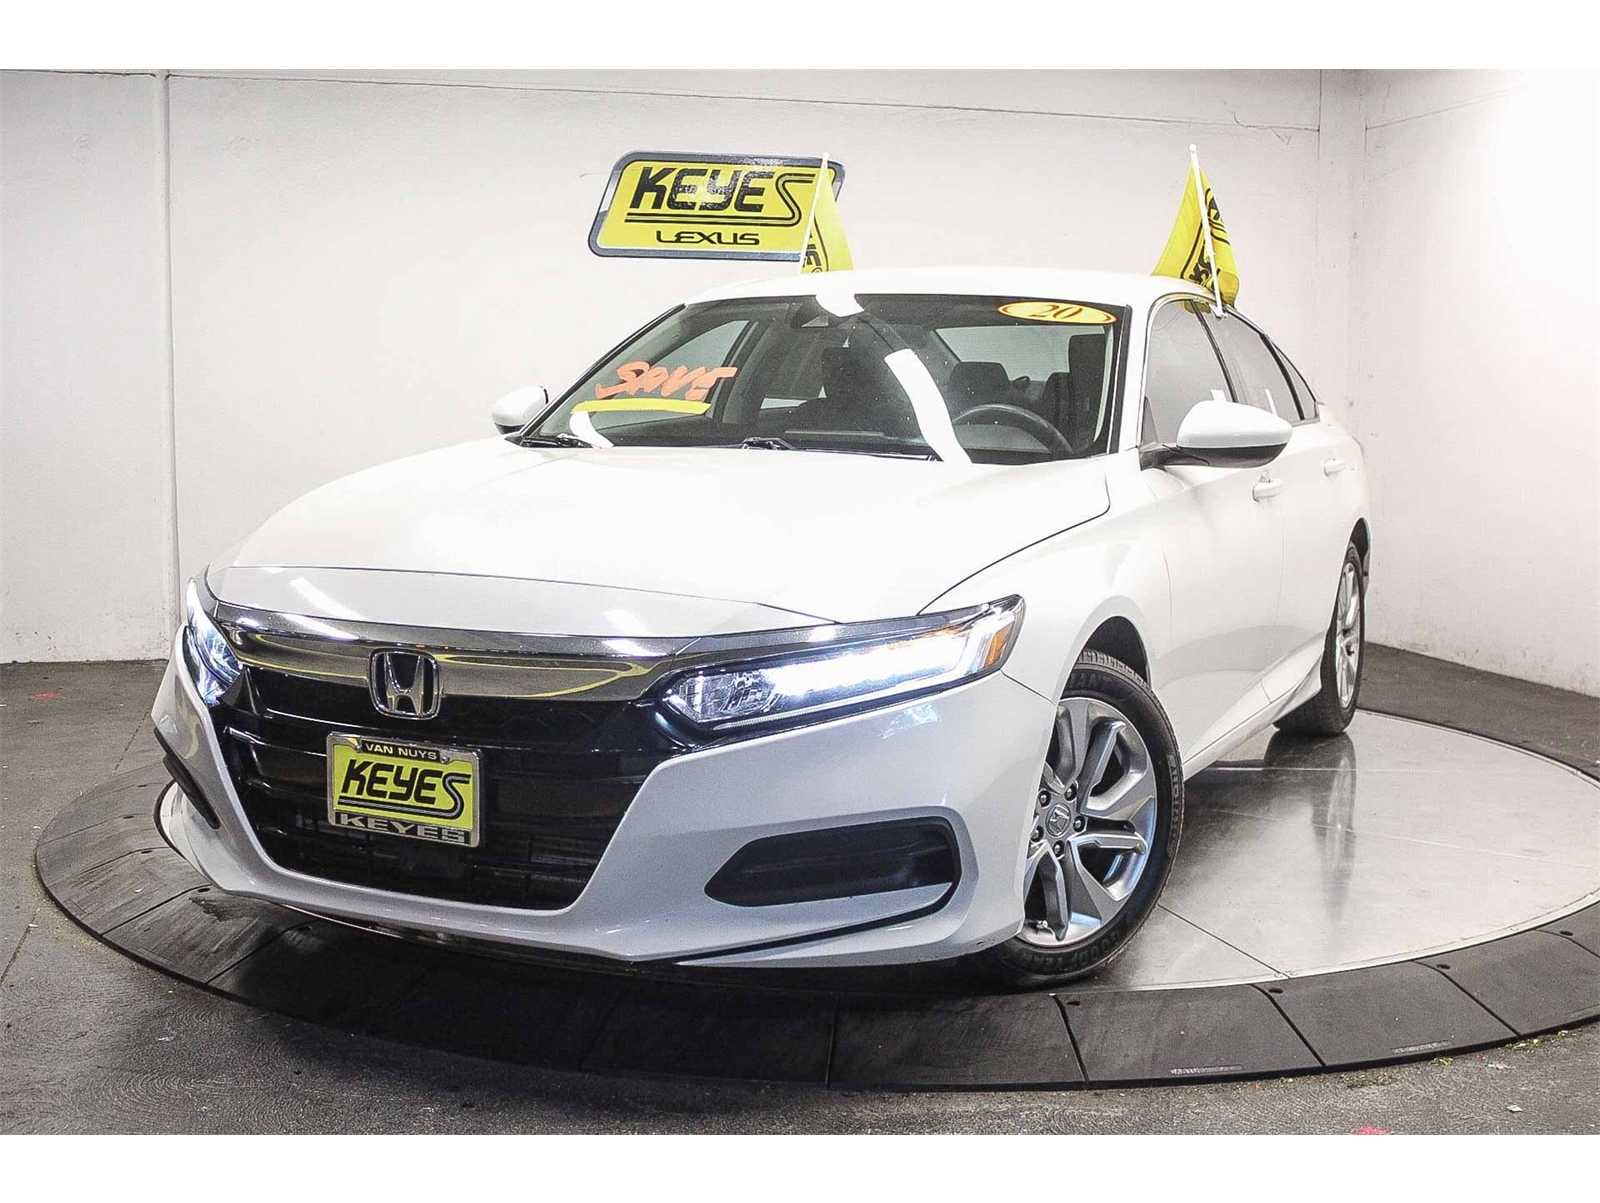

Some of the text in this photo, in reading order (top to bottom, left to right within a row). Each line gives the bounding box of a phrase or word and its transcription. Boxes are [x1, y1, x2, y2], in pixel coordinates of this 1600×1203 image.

[625, 166, 816, 227] KEYES
[656, 231, 760, 246] LEXUS
[1027, 304, 1084, 319] 20
[595, 361, 738, 400] SAVE
[365, 743, 437, 760] VAN NUYS
[338, 759, 471, 819] KEYES
[340, 813, 464, 842] KEYES
